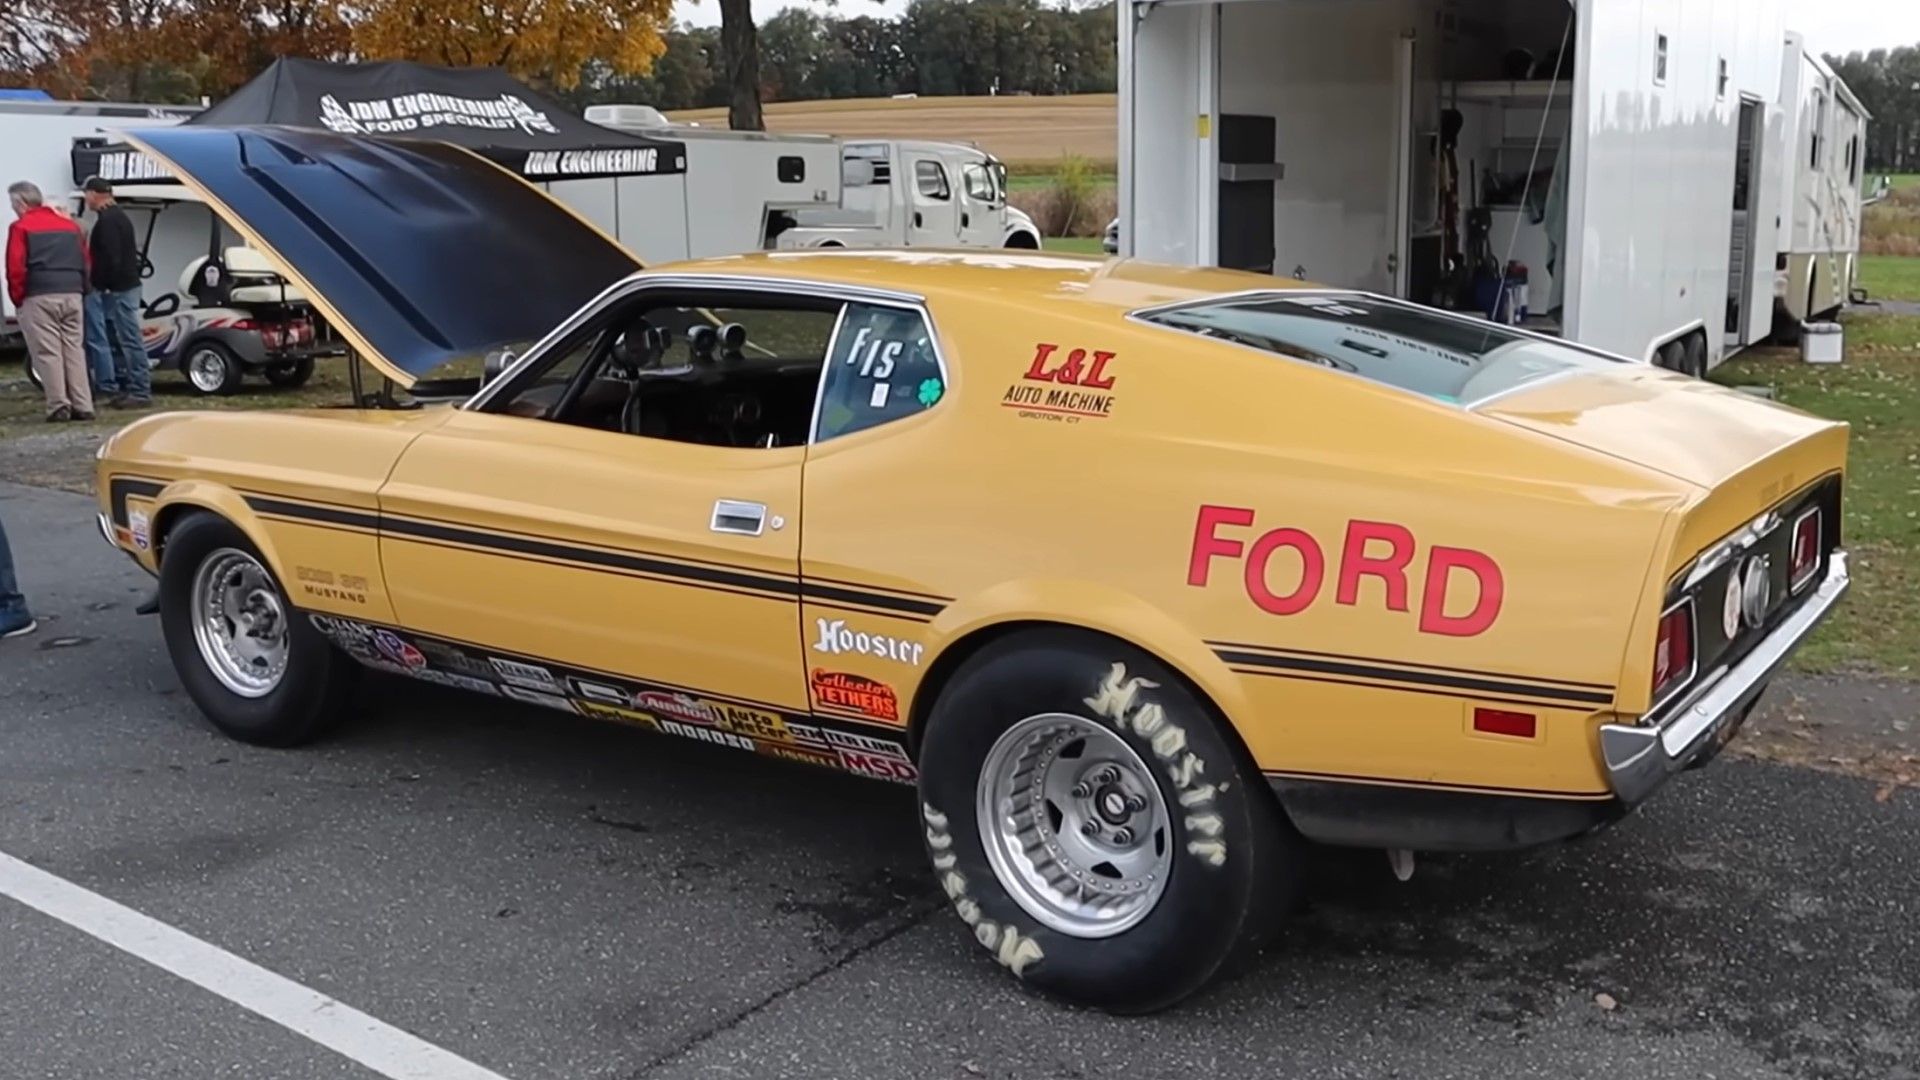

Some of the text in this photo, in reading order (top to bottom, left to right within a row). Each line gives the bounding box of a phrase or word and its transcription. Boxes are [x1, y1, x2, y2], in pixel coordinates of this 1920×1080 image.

[392, 93, 511, 118] ENGINEERING
[365, 113, 518, 133] FORD SPECIALIST
[560, 148, 658, 174] ENGINEERING
[1023, 343, 1117, 390] L&L
[1003, 385, 1115, 413] AUTO MACHINE
[1018, 411, 1082, 425] GROTON CT
[1187, 504, 1504, 637] FORD
[304, 584, 367, 605] MUSTANG
[813, 617, 923, 666] Hoosier
[812, 667, 892, 697] Collector
[815, 684, 895, 714] TETHERS
[727, 706, 774, 727] Auto
[731, 718, 789, 740] Meter
[844, 750, 918, 781] MSD
